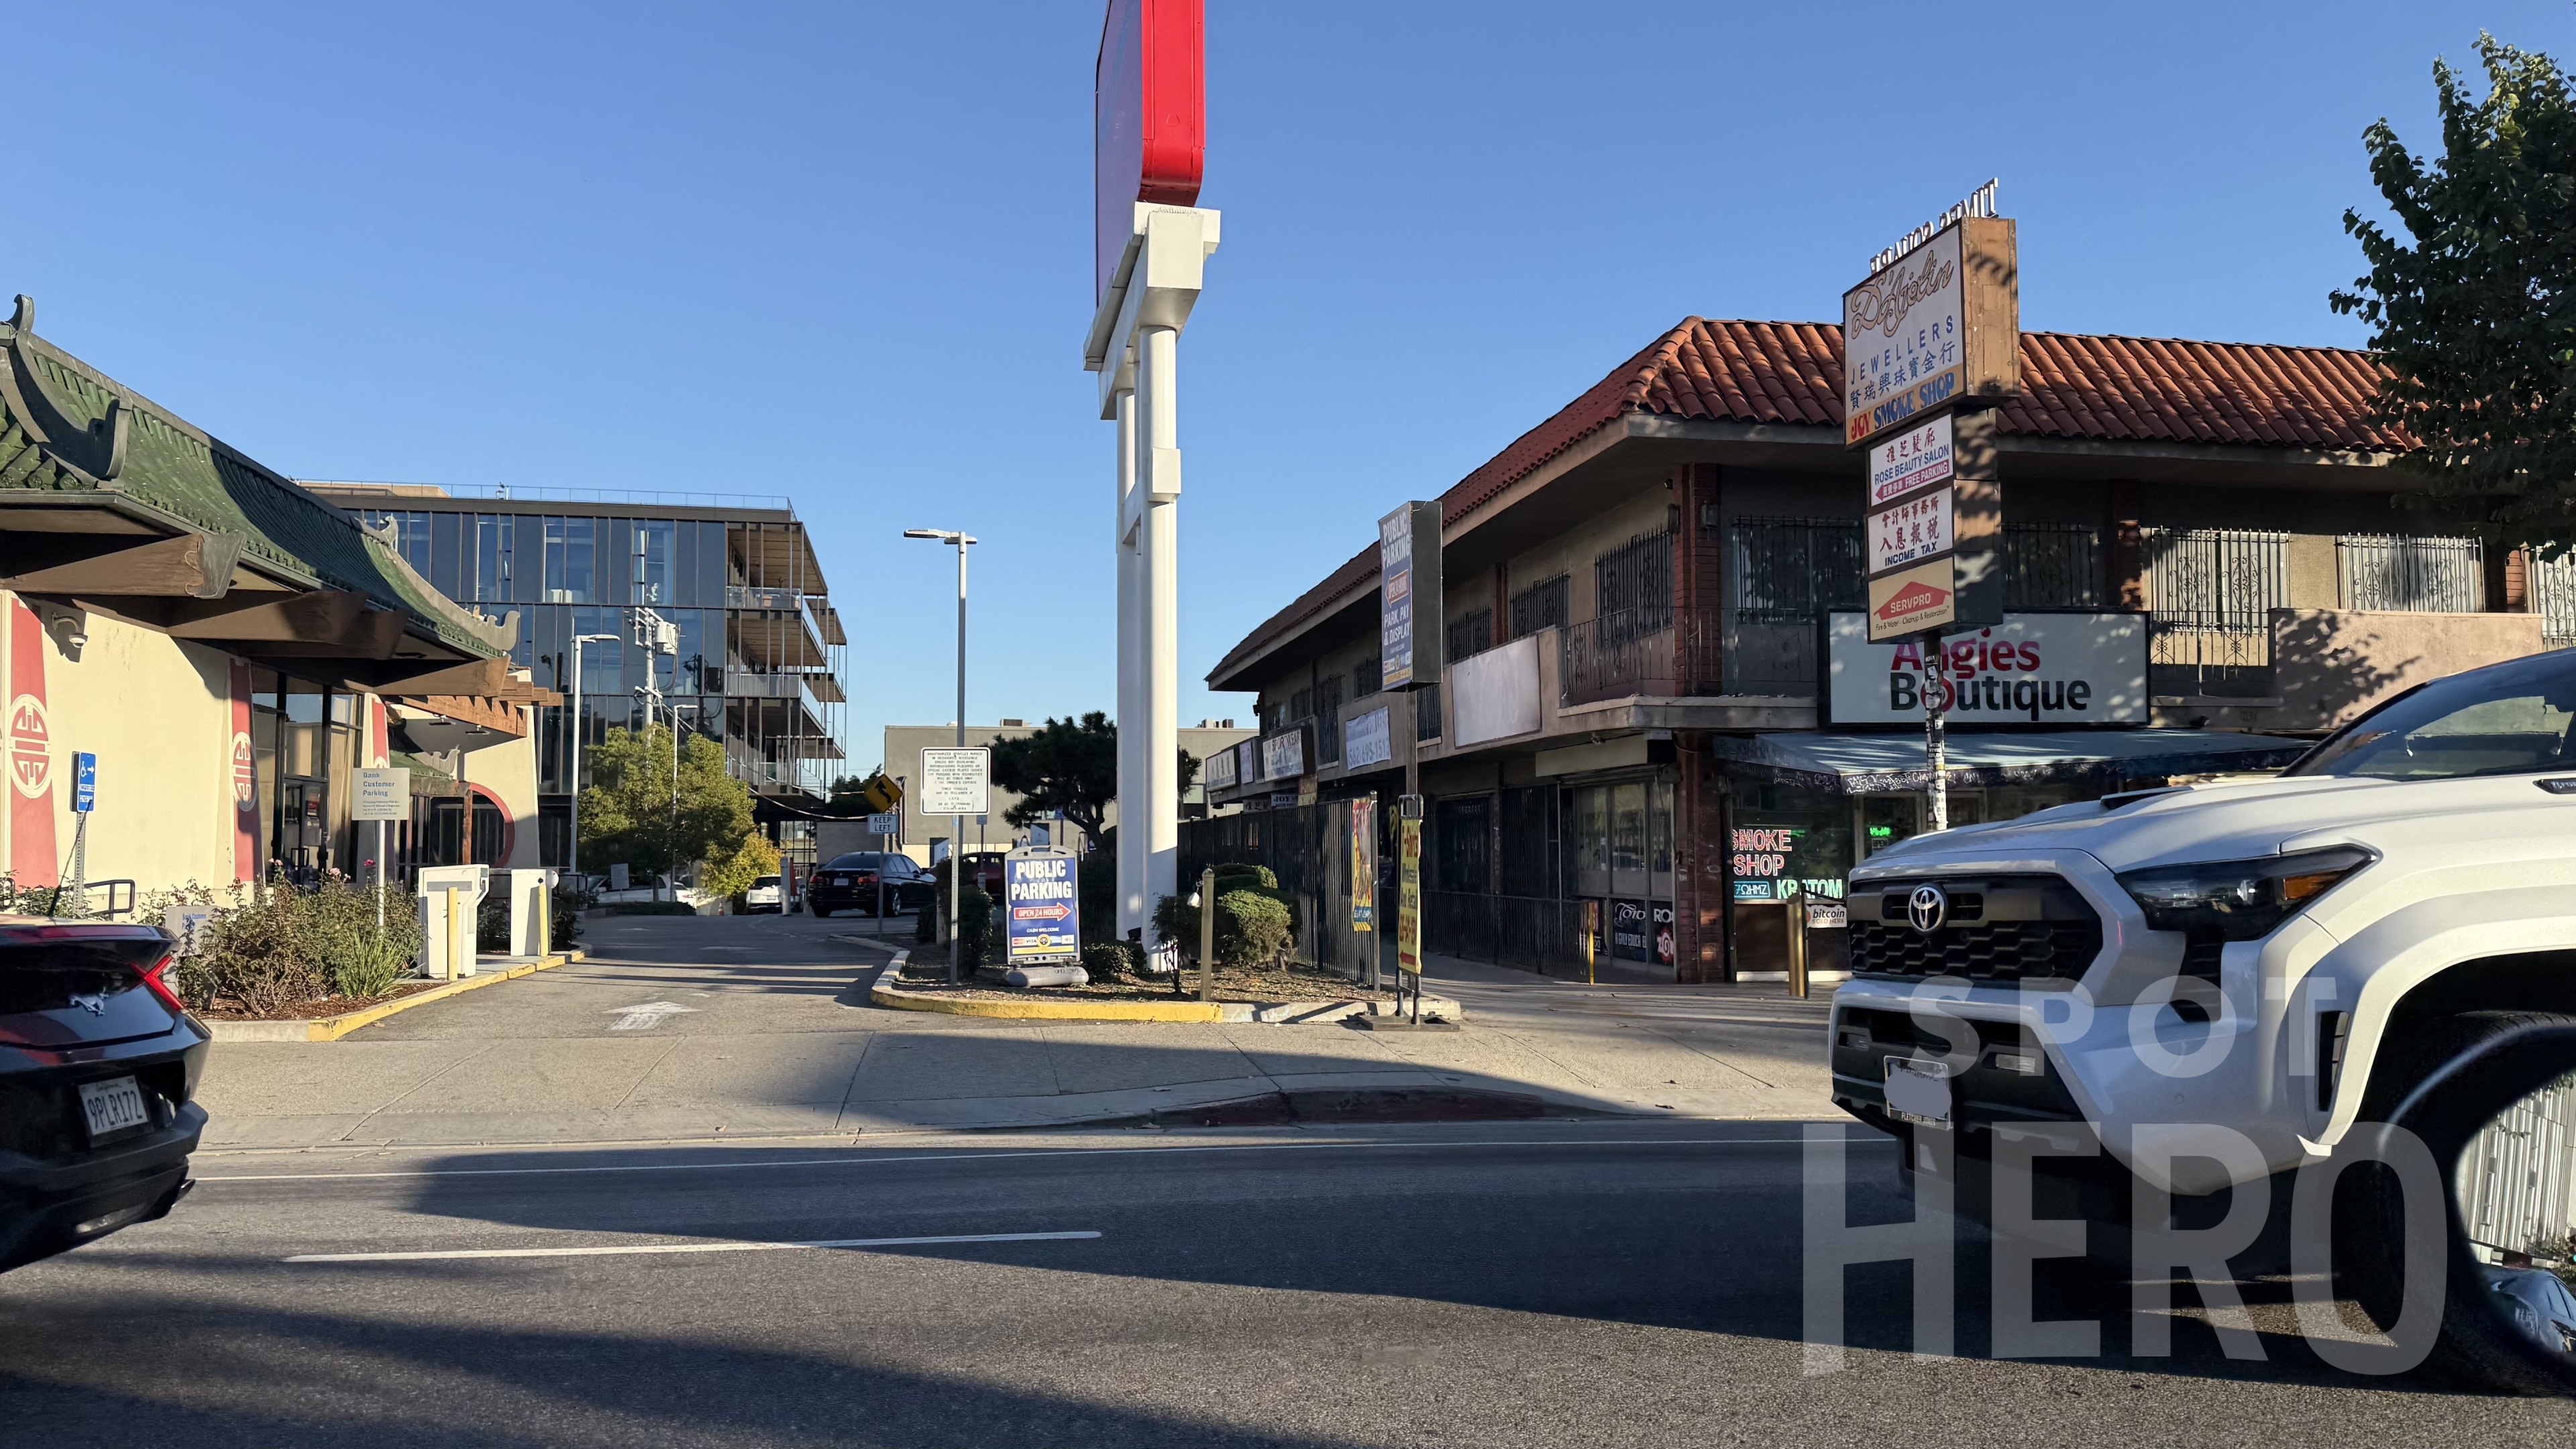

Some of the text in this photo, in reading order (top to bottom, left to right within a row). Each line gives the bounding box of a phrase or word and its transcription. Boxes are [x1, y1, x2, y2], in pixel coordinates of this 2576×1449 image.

[1851, 315, 1953, 385] JEWELLERS
[1851, 372, 1955, 440] JOY SMOKE SHOP
[1875, 443, 1949, 485] ROSE BEAUTY SALON
[1905, 462, 1947, 488] FREE PARKING
[1383, 511, 1407, 546] PUBLIC
[1383, 535, 1410, 570] PARKING
[1885, 541, 1937, 567] INCOME TAX
[1400, 603, 1409, 621] PAY
[1890, 592, 1931, 613] SERVPRO
[1384, 621, 1410, 646] & DISPLAY
[1732, 828, 1792, 851] SMOKE
[1016, 860, 1066, 879] PUBLIC
[1733, 854, 1784, 876] SHOP
[1011, 881, 1072, 900] PARKING
[1018, 908, 1063, 917] OPEN 24 HOURS
[1654, 908, 1674, 923] RO
[1813, 908, 1845, 918] bitcoin
[88, 1090, 143, 1130] 9PLR172
